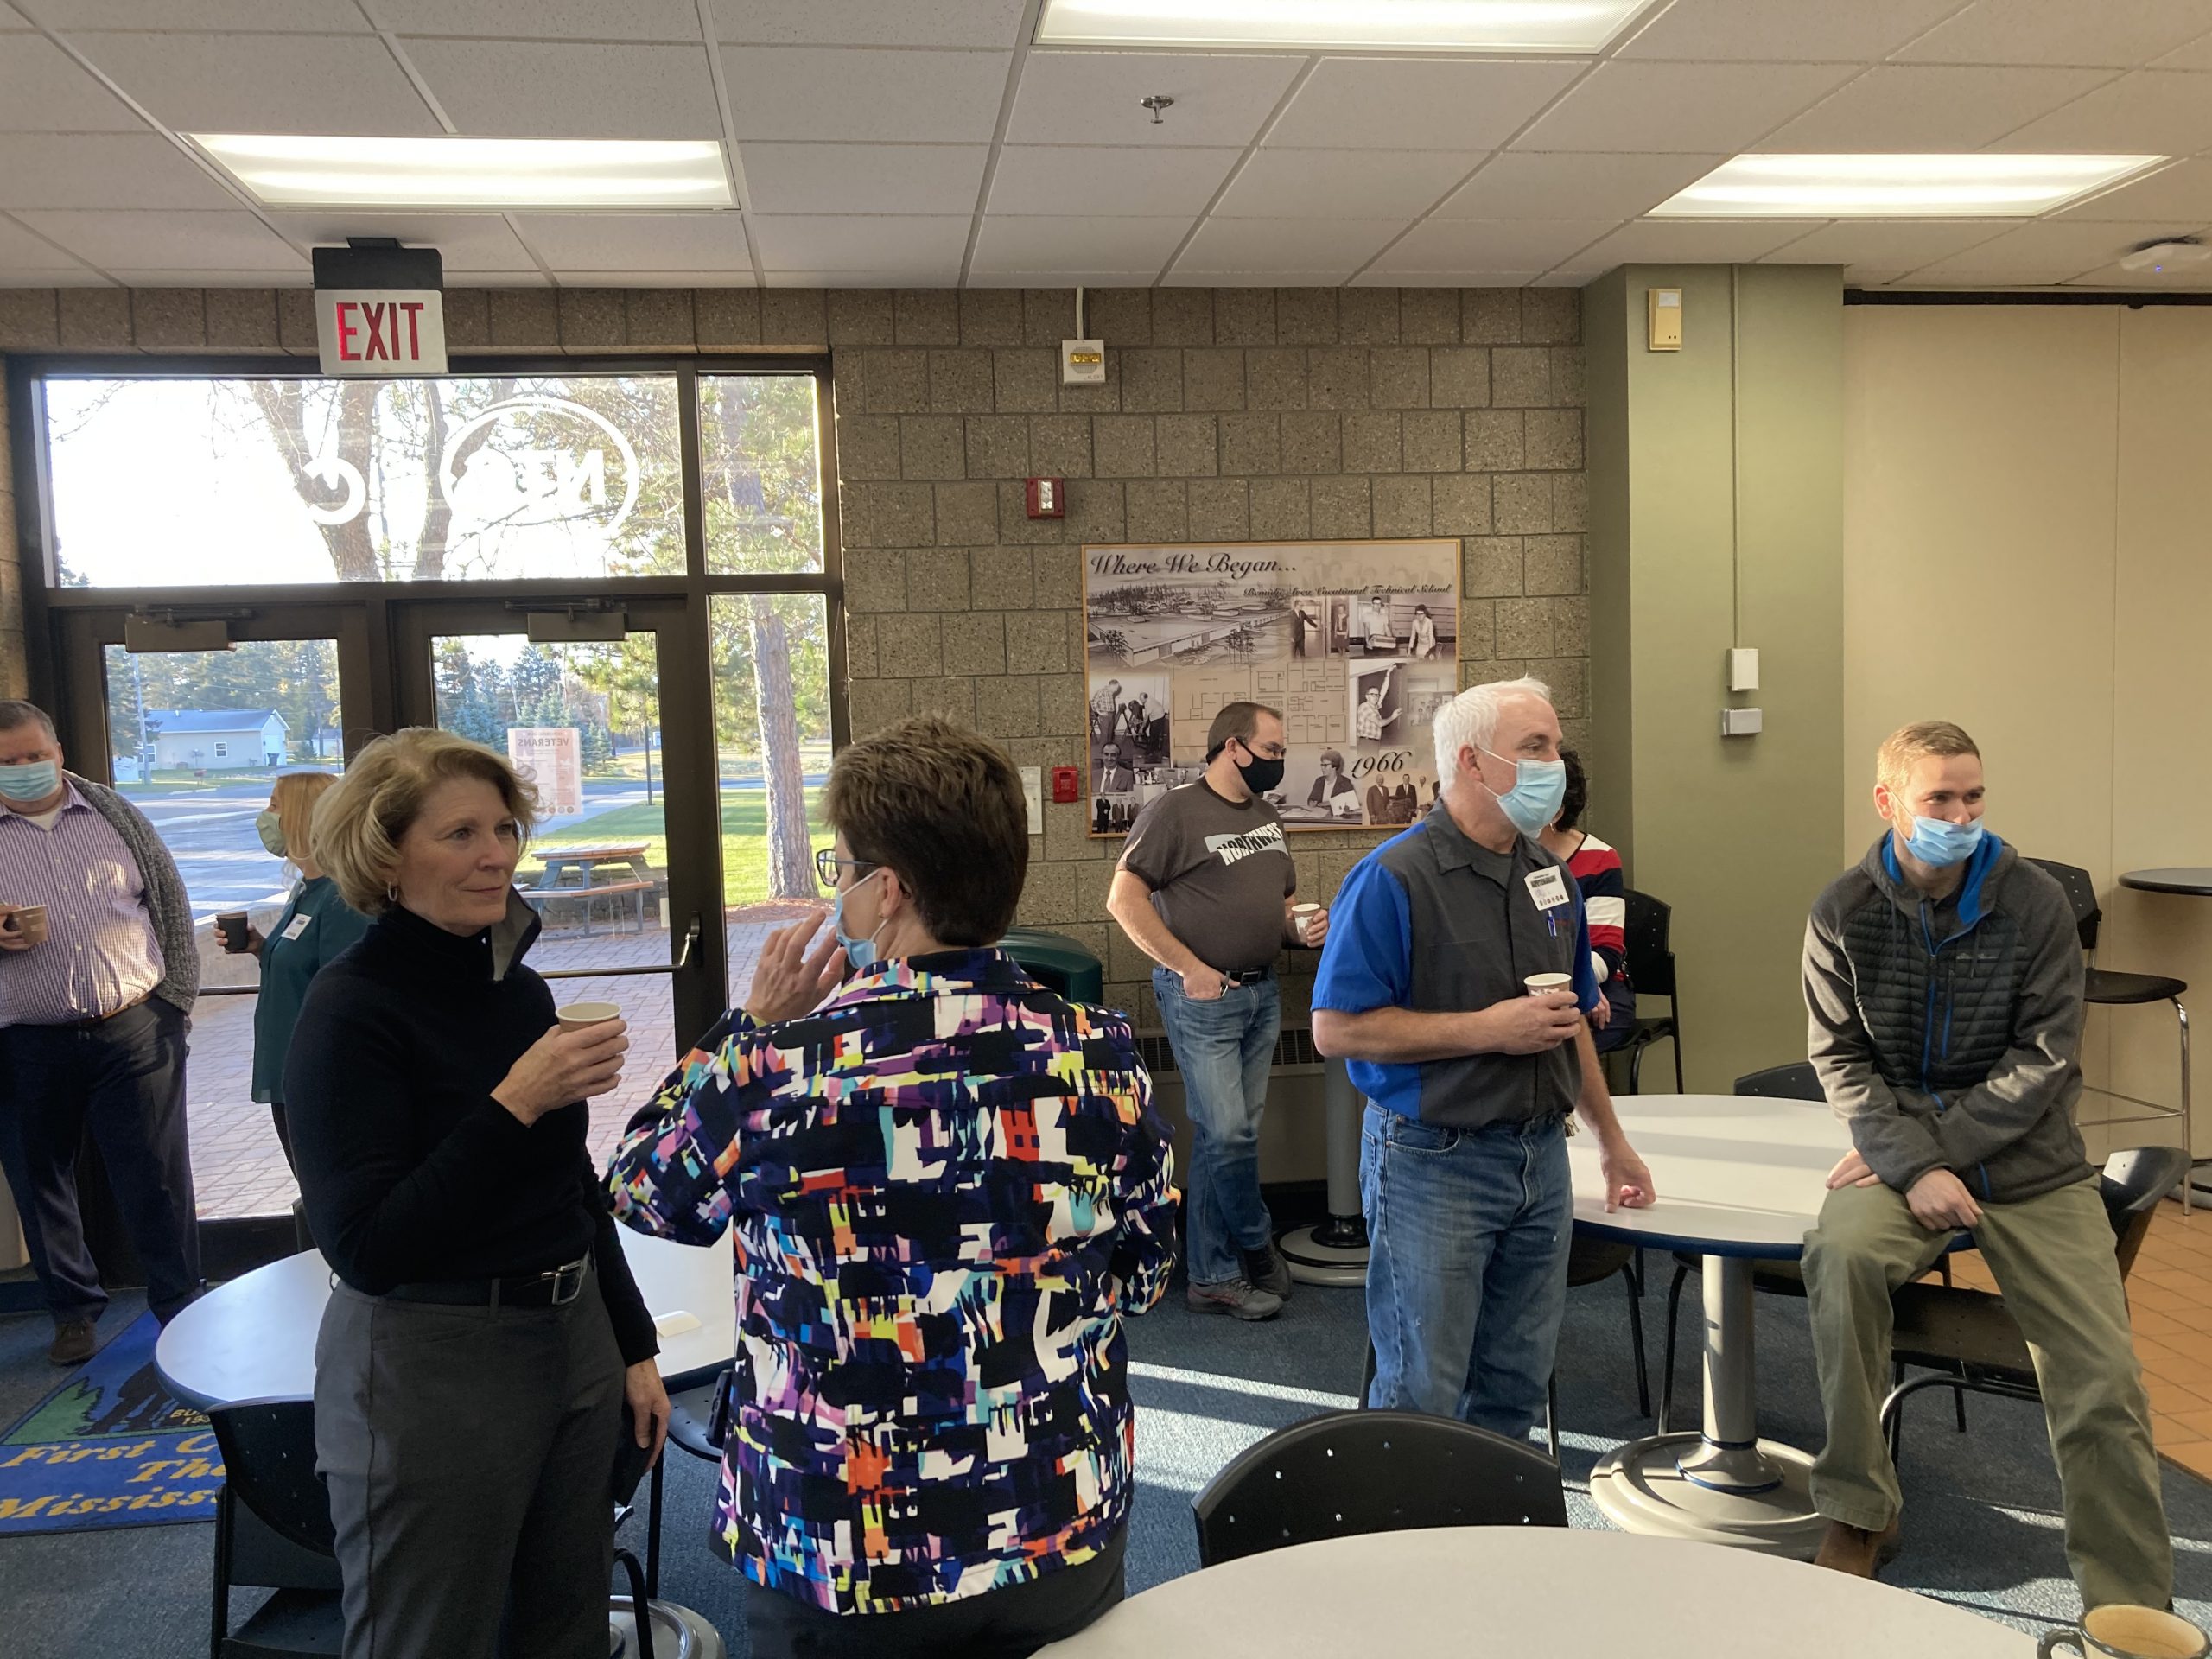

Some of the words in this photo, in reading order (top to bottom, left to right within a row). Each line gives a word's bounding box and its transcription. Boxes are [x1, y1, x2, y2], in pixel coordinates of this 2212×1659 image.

[336, 302, 424, 360] EXIT
[1091, 553, 1156, 575] Where
[1166, 553, 1198, 574] We
[1207, 552, 1296, 580] Began...
[1370, 584, 1417, 595] Technical
[1417, 583, 1452, 594] School
[1351, 751, 1412, 779] 1966
[1217, 822, 1283, 866] NORTHWEST
[0, 1440, 156, 1467] First
